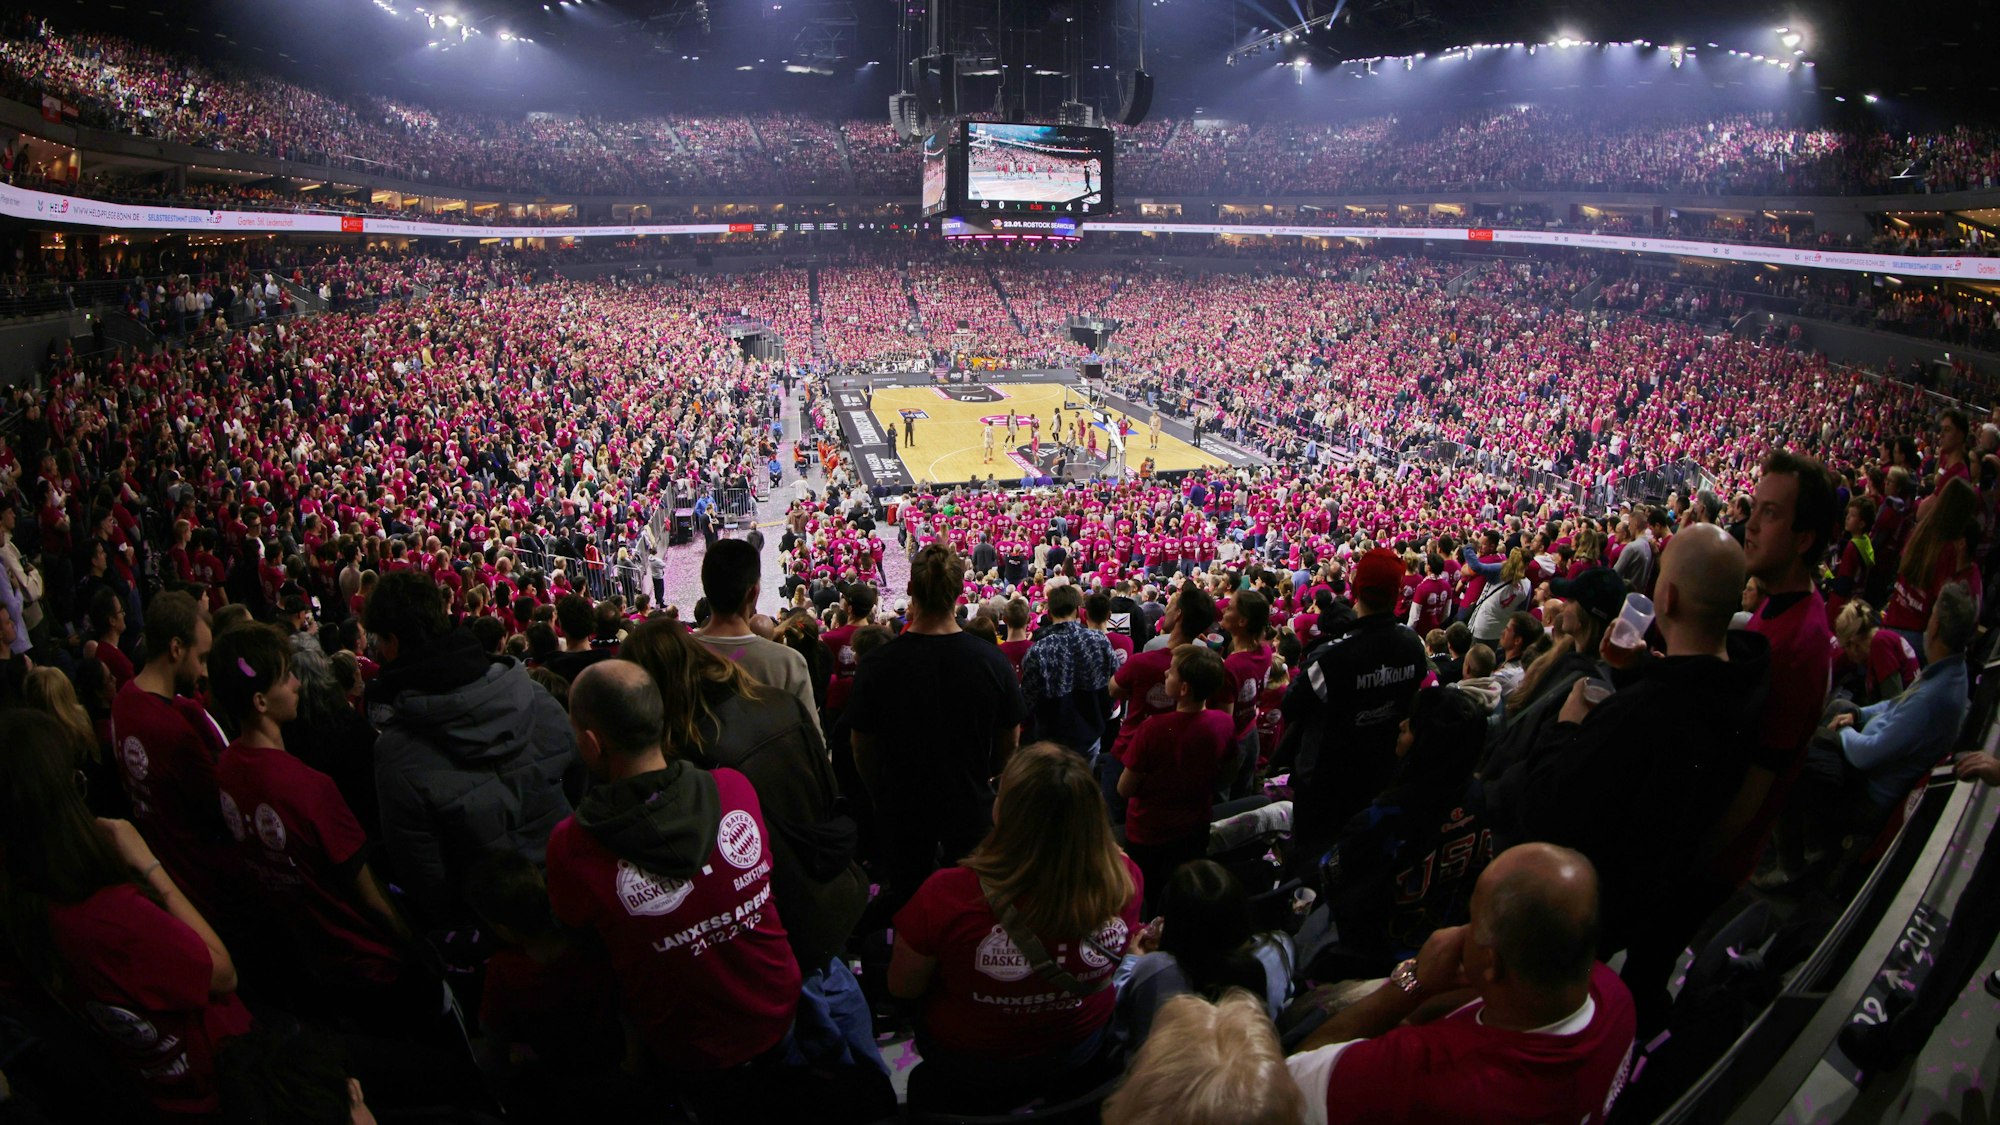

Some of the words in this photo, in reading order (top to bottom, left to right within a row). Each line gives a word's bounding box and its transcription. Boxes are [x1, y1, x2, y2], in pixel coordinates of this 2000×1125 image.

[1066, 202, 1072, 211] 4
[651, 912, 732, 953] LANXESS
[690, 912, 762, 957] 21.12.2025
[972, 991, 1057, 1006] LANXESS
